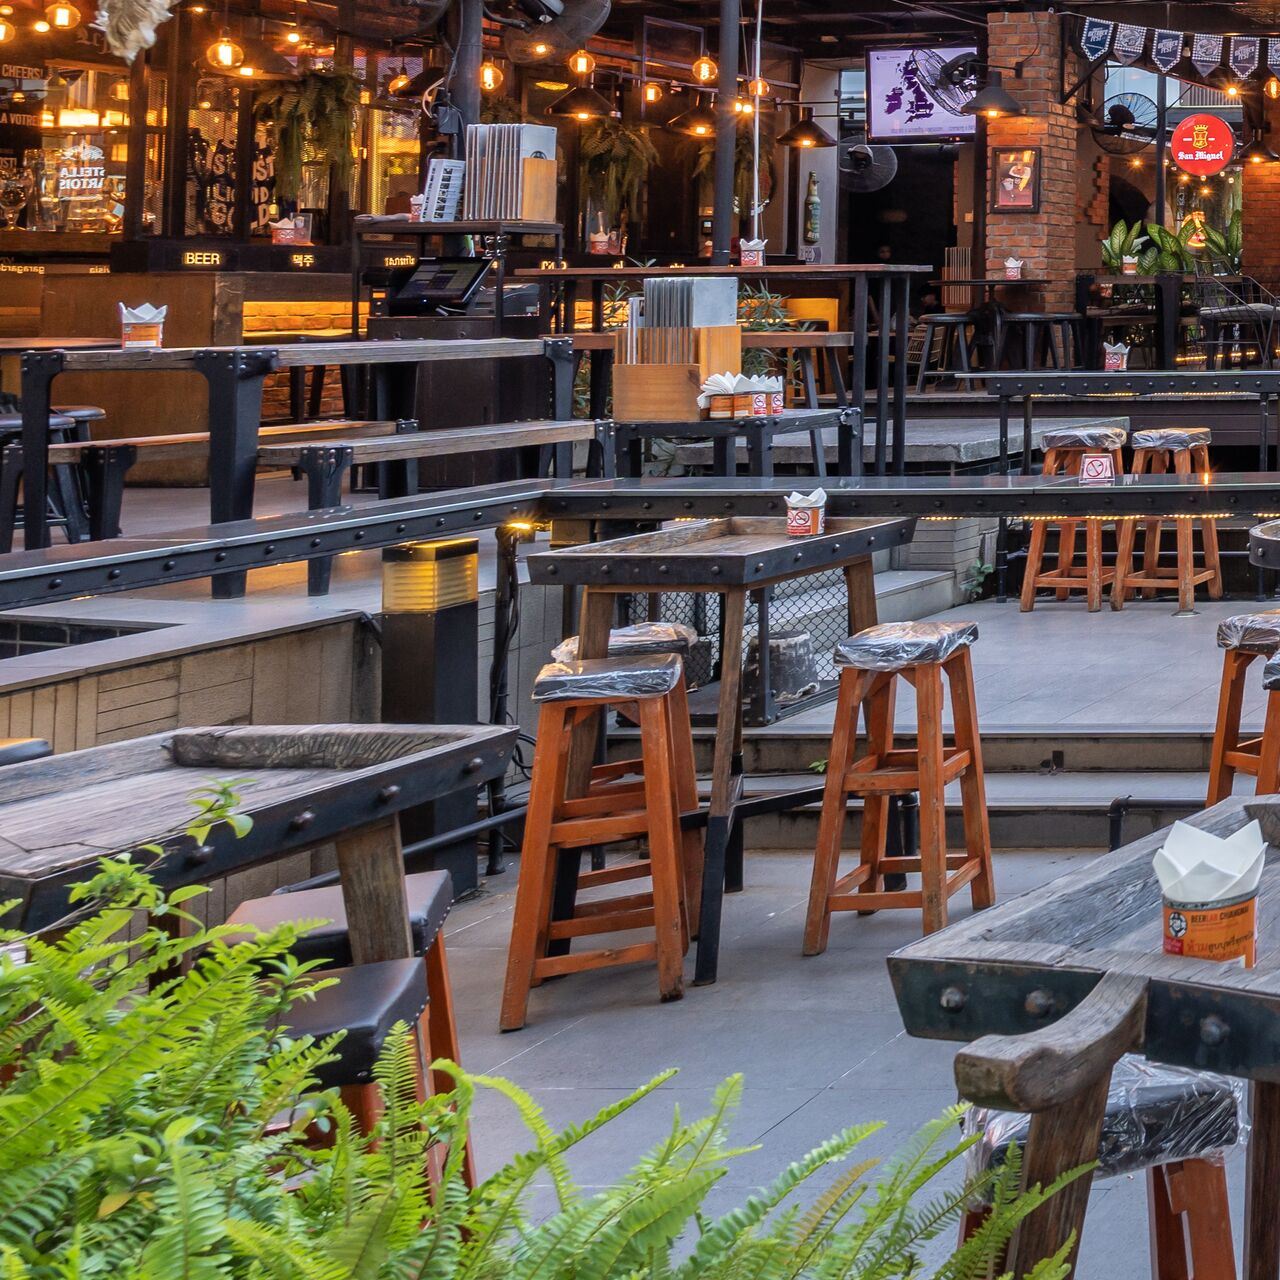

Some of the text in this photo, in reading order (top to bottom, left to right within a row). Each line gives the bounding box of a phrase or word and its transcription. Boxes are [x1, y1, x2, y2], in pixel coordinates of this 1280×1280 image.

[2, 64, 43, 79] CHEERS!
[1178, 151, 1223, 161] San Miguel
[184, 252, 221, 265] BEER
